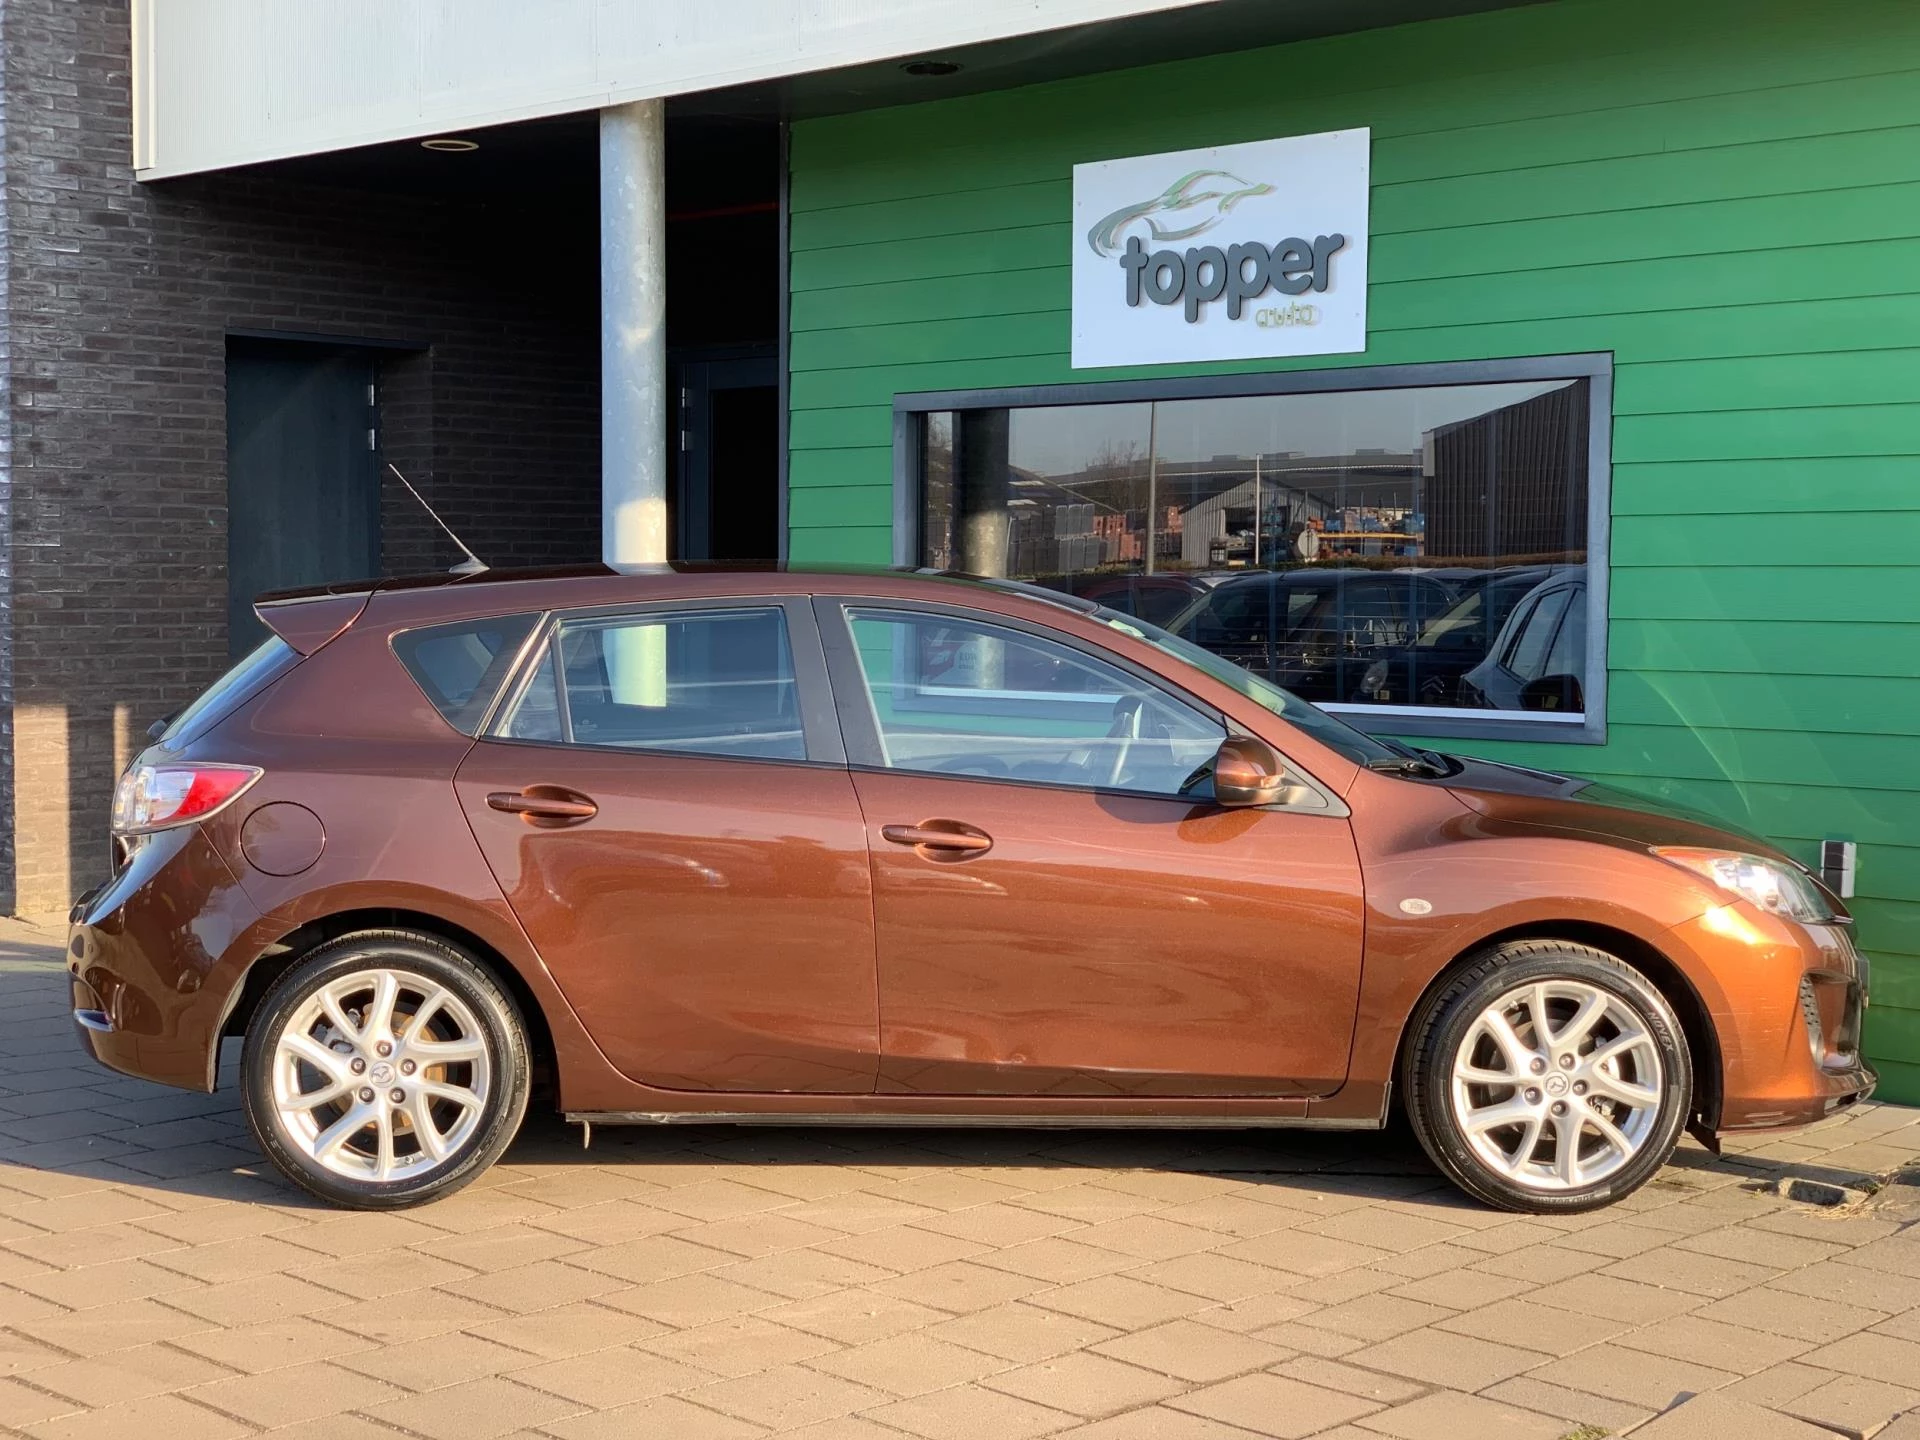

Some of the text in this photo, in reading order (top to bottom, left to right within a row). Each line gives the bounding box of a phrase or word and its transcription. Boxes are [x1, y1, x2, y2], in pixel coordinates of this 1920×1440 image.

[1119, 233, 1345, 323] topper
[1255, 302, 1314, 327] auto
[1647, 1012, 1675, 1052] NOVEX
